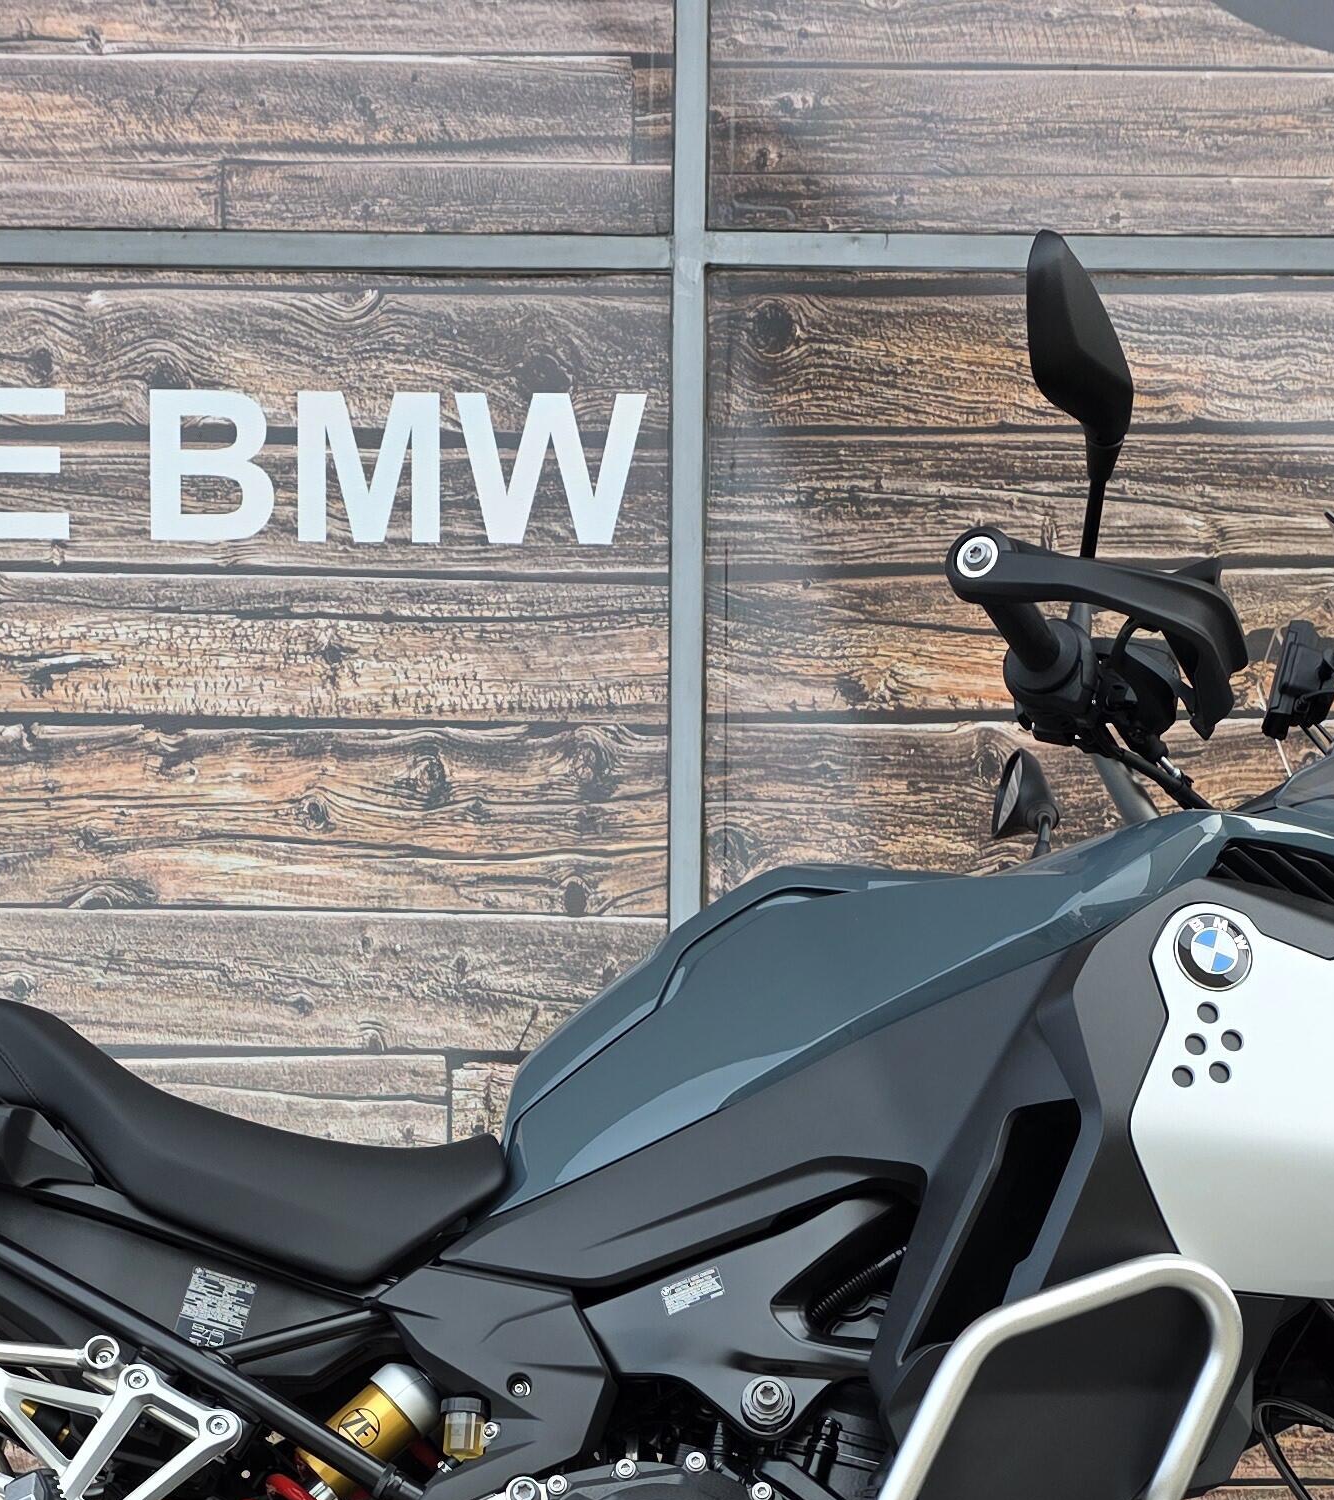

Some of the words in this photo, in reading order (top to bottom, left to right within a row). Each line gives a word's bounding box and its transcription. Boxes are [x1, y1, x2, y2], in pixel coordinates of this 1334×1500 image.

[148, 389, 648, 545] BMW
[1188, 916, 1248, 950] BMW
[338, 1408, 380, 1448] ZF
